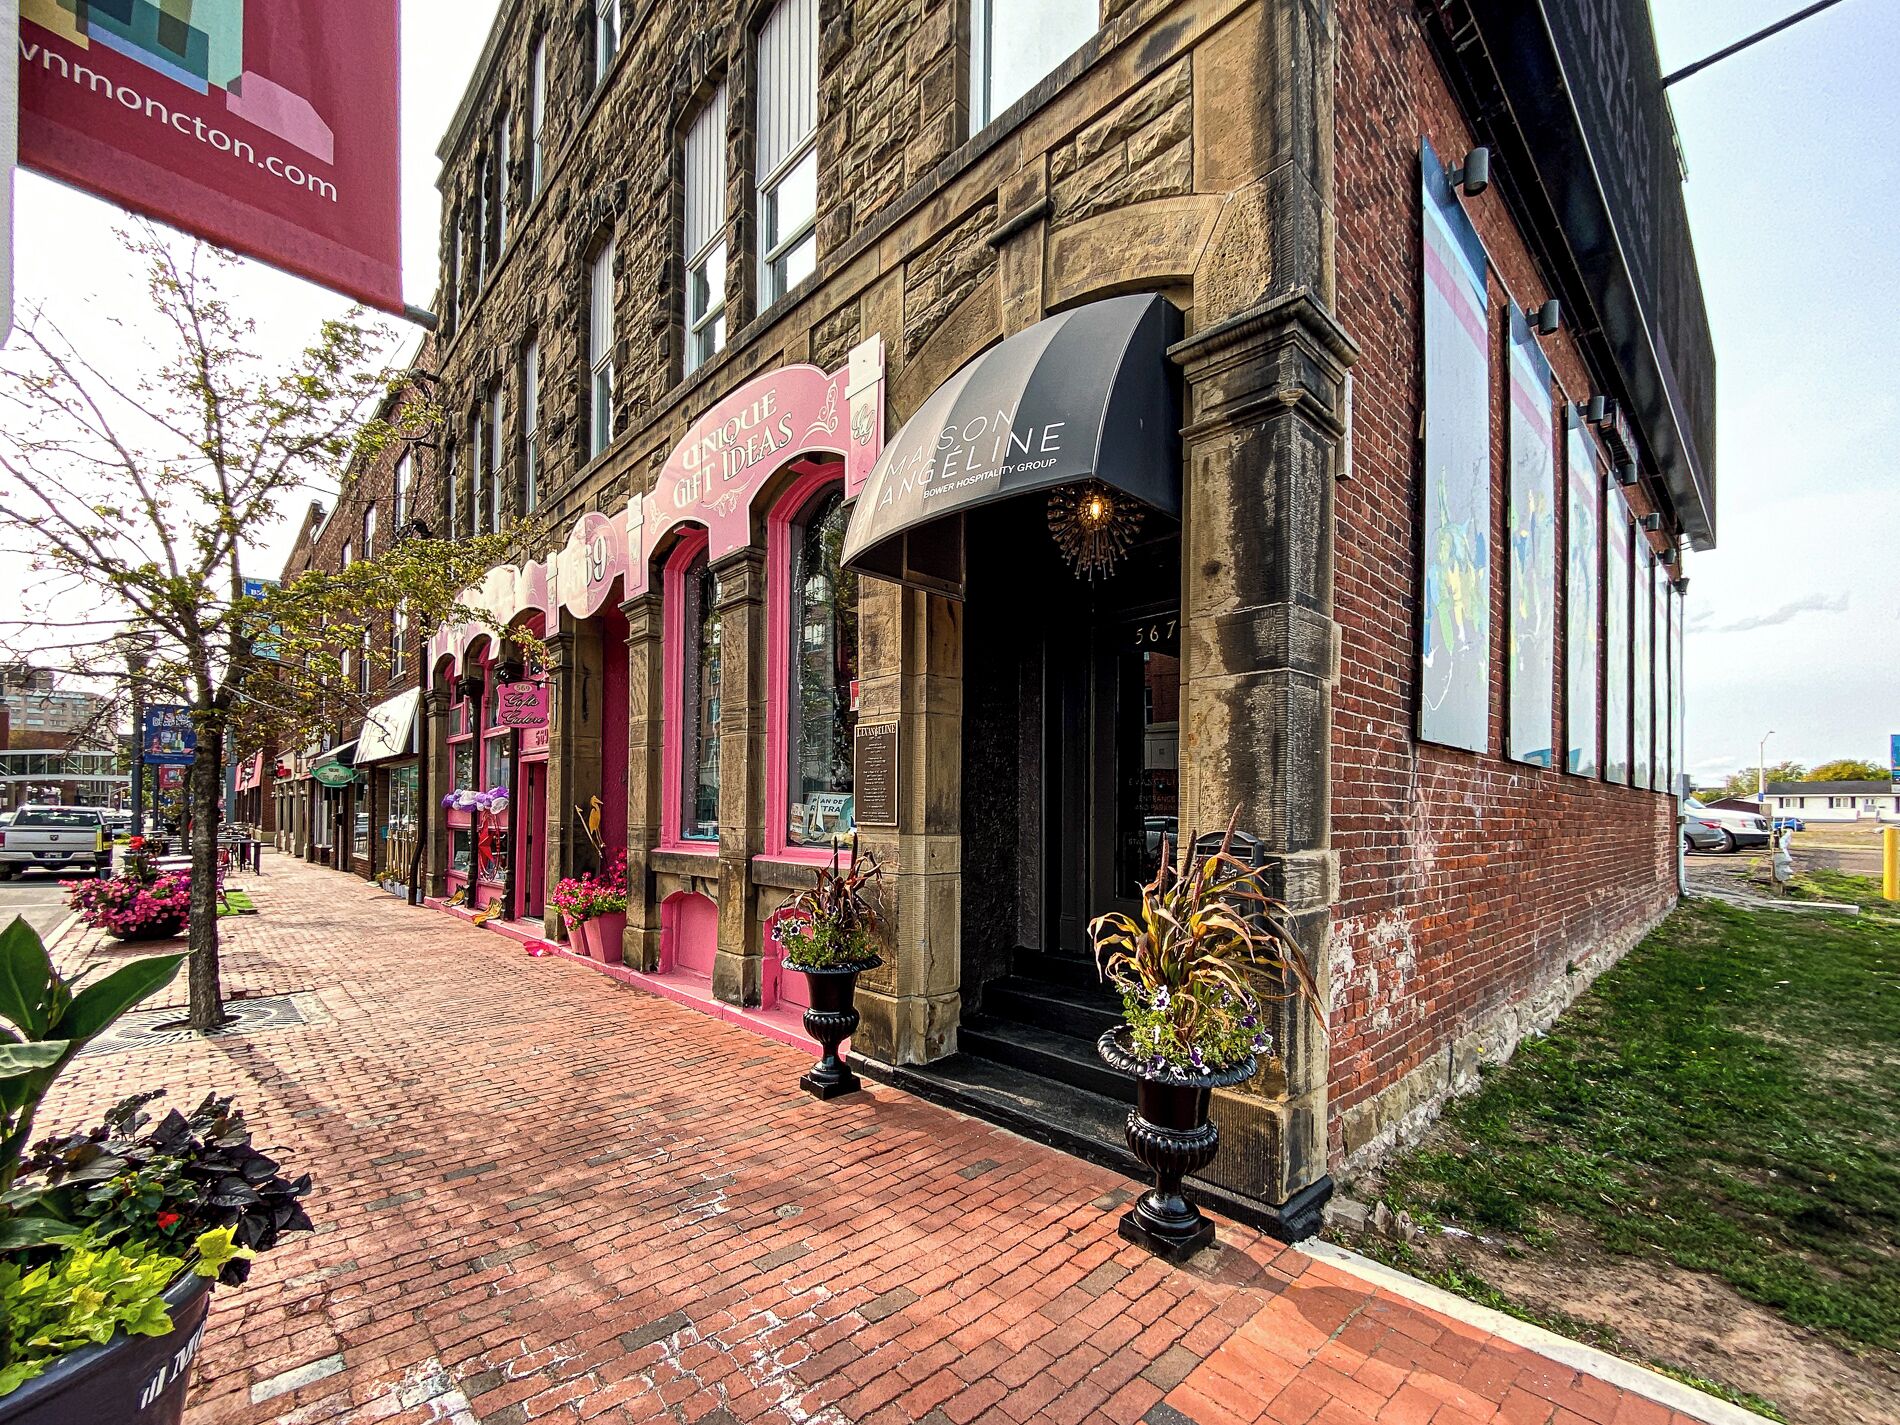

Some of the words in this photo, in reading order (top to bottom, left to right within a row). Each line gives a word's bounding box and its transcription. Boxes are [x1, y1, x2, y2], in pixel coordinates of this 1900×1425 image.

[673, 462, 716, 509] GIFT
[721, 411, 794, 481] IDEAS
[682, 389, 777, 470] UNIQUE
[878, 421, 1066, 511] ANGÉLINE
[883, 401, 1018, 483] MAISON
[923, 482, 955, 499] BOWER
[956, 464, 1016, 489] HOSPITALITY
[1016, 458, 1057, 472] GROUP
[1135, 619, 1177, 645] 567
[810, 804, 841, 813] RTRA
